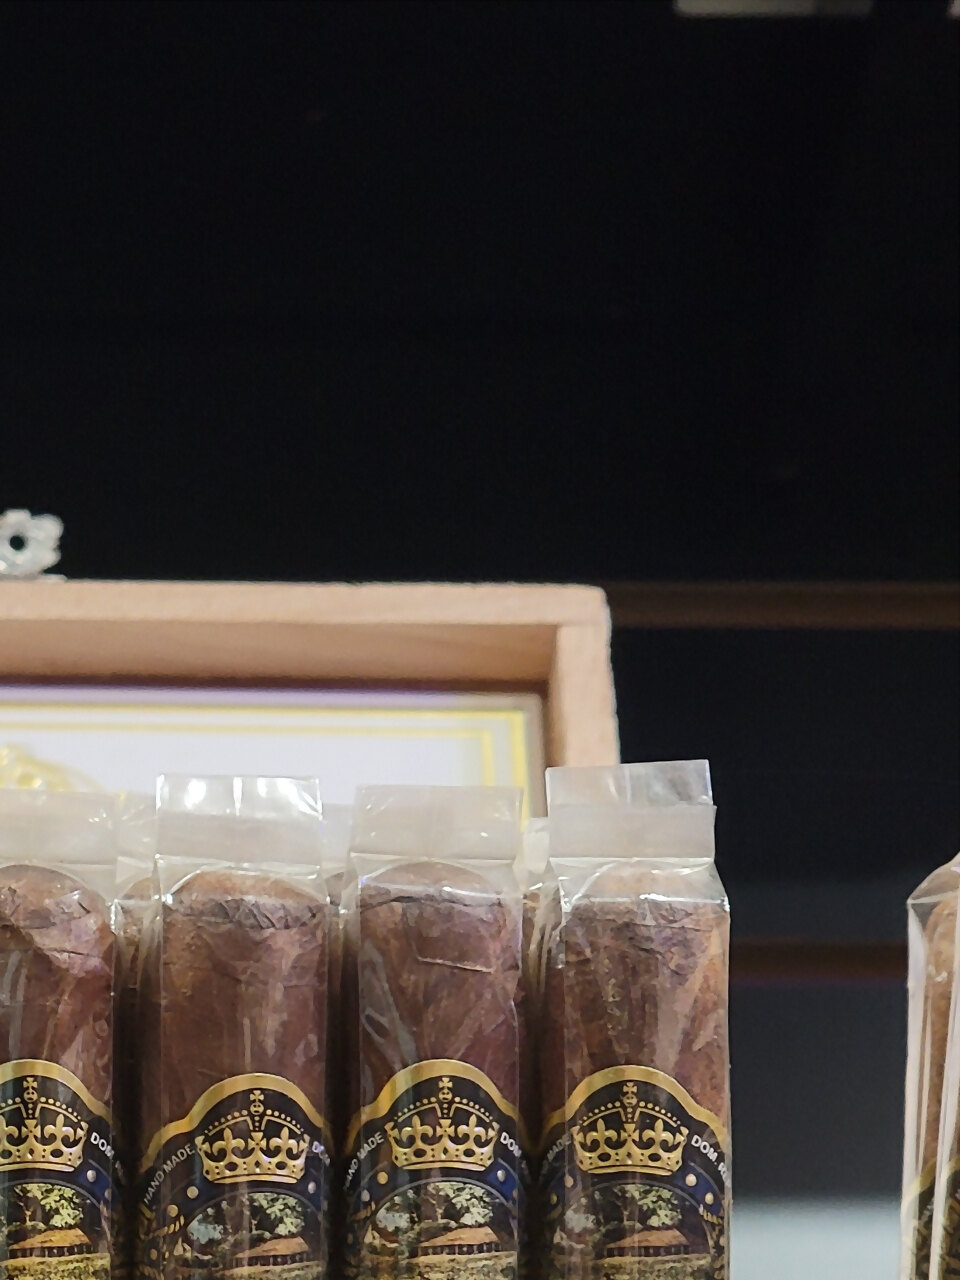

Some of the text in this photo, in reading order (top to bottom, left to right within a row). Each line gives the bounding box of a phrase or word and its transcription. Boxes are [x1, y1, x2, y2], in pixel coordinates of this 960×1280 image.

[357, 1131, 384, 1160] MADE
[144, 1170, 165, 1204] HAND
[163, 1143, 196, 1174] MADE
